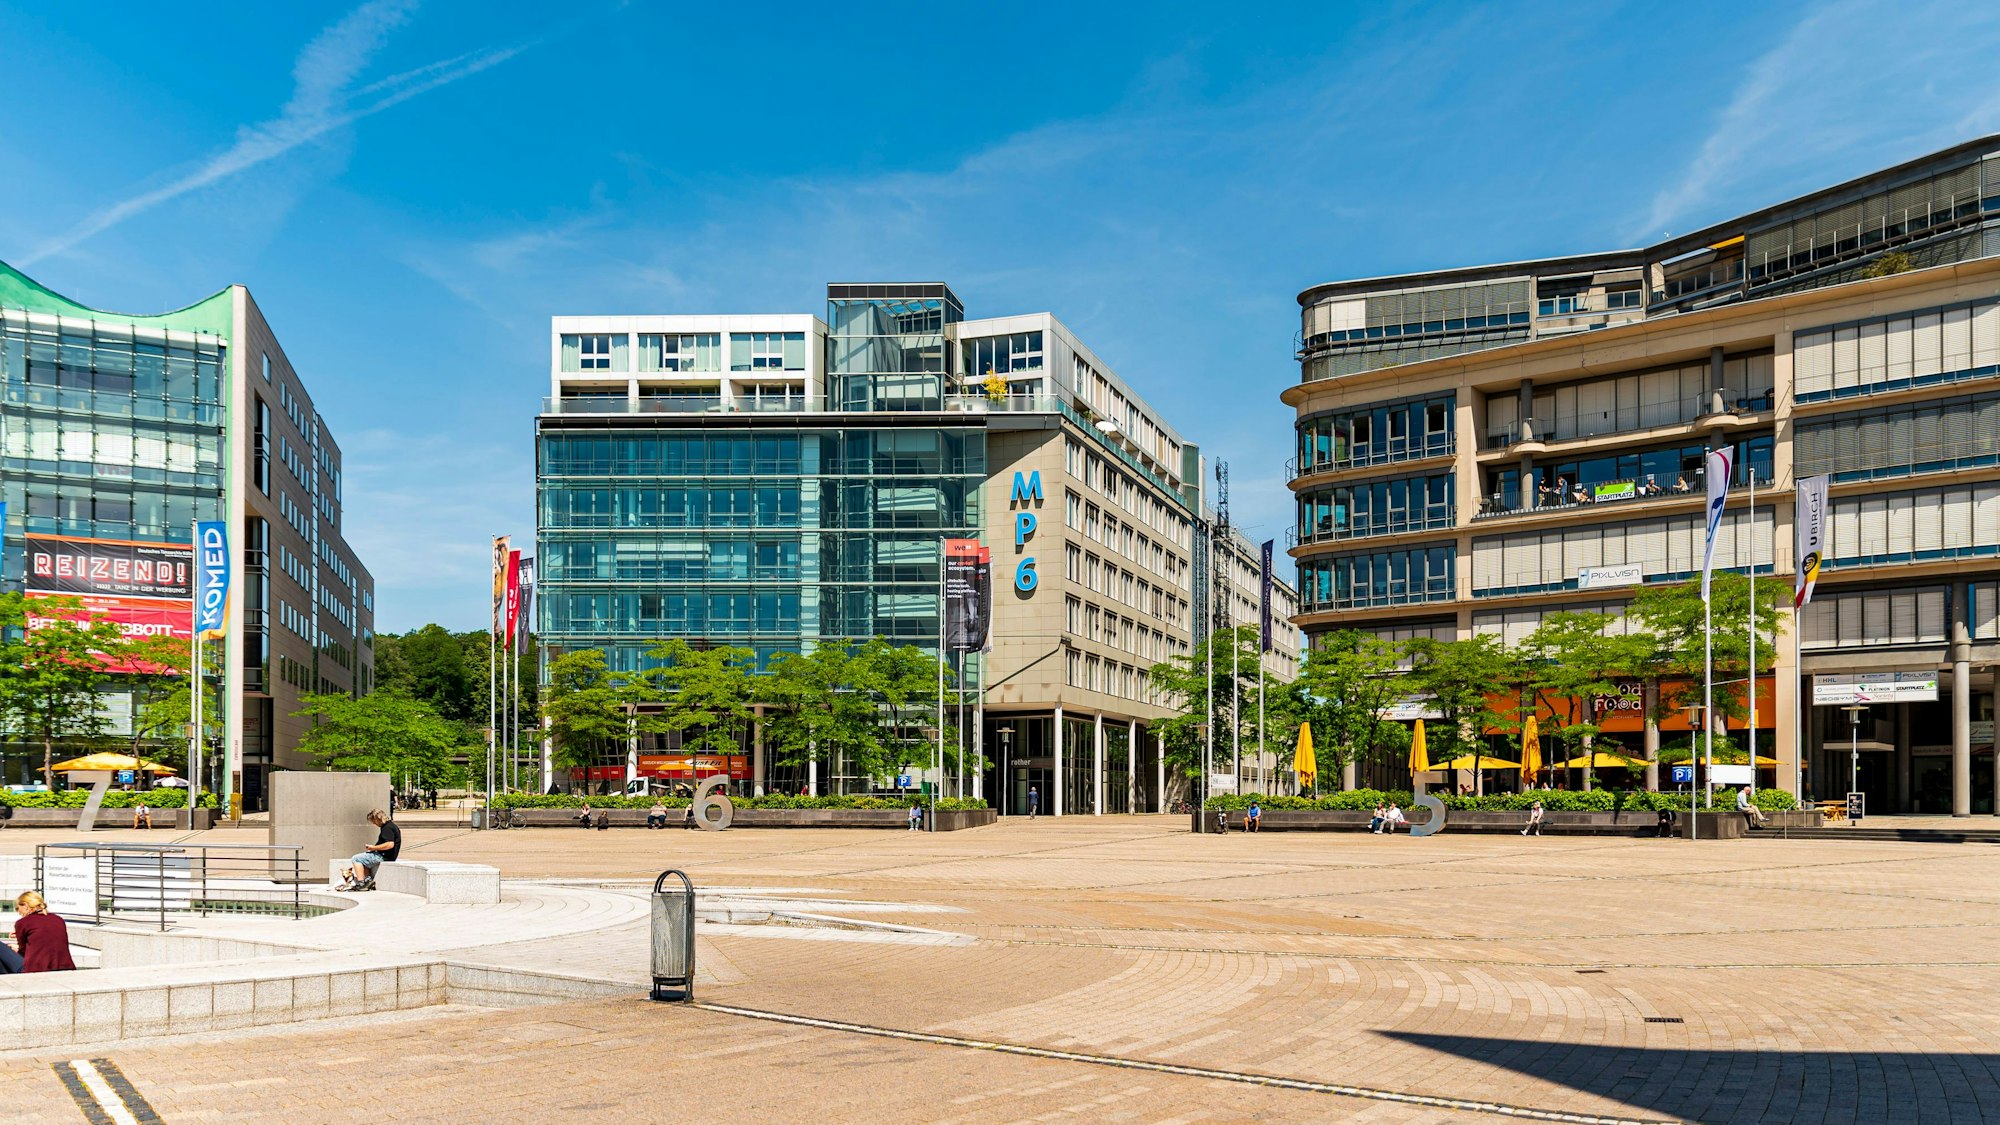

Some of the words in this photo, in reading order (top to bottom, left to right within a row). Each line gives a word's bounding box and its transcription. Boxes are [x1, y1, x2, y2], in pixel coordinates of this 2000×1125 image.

[1597, 492, 1633, 501] STARTPLATZ
[1809, 492, 1819, 547] UBIRCH
[34, 552, 187, 585] REIZEND!
[155, 586, 187, 594] WERBUNG
[201, 527, 226, 626] KOMED
[1594, 697, 1642, 712] Food
[1010, 758, 1031, 766] rother
[68, 770, 112, 832] 7
[693, 773, 734, 832] 6
[1410, 771, 1449, 836] 5
